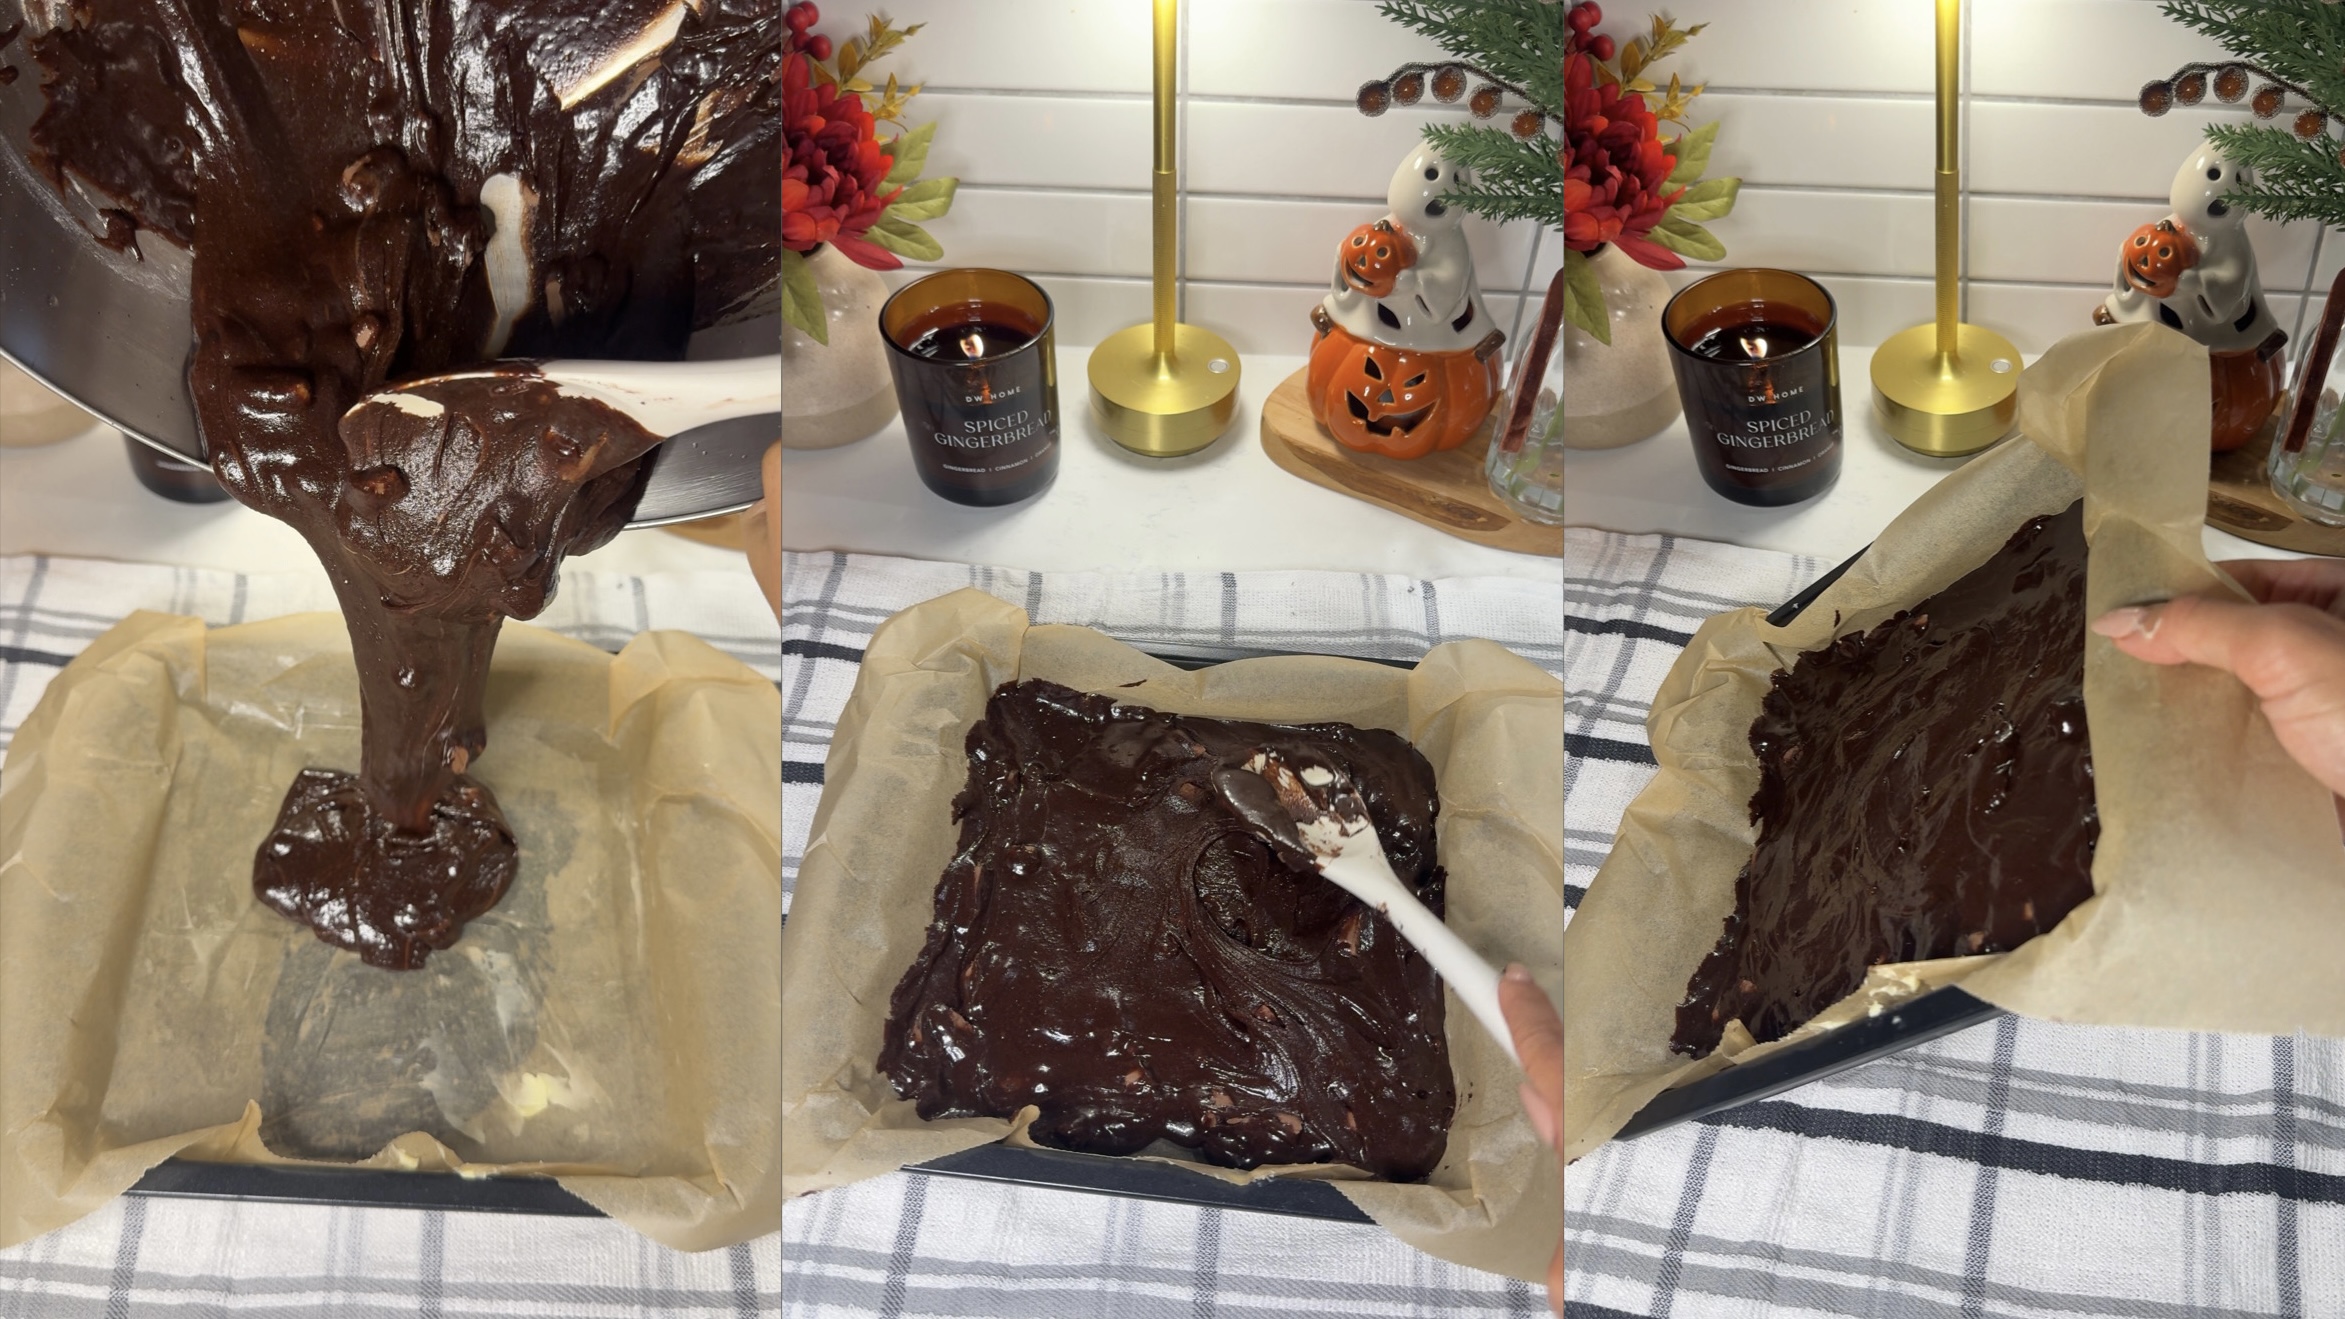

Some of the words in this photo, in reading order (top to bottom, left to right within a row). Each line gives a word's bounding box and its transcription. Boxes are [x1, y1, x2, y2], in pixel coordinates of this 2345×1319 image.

[990, 386, 1021, 400] HOME
[1748, 395, 1766, 403] DW
[1773, 386, 1804, 400] HOME
[934, 409, 1051, 449] GINGERBREAD
[963, 410, 1029, 434] SPICED
[1716, 409, 1835, 449] GINGERBREAD
[1746, 409, 1812, 433] SPICED
[942, 463, 986, 473] GINGERBREAD
[994, 458, 1029, 472] CINNAMON
[1725, 463, 1769, 473] GINGERBREAD
[1777, 458, 1812, 472] CINNAMON
